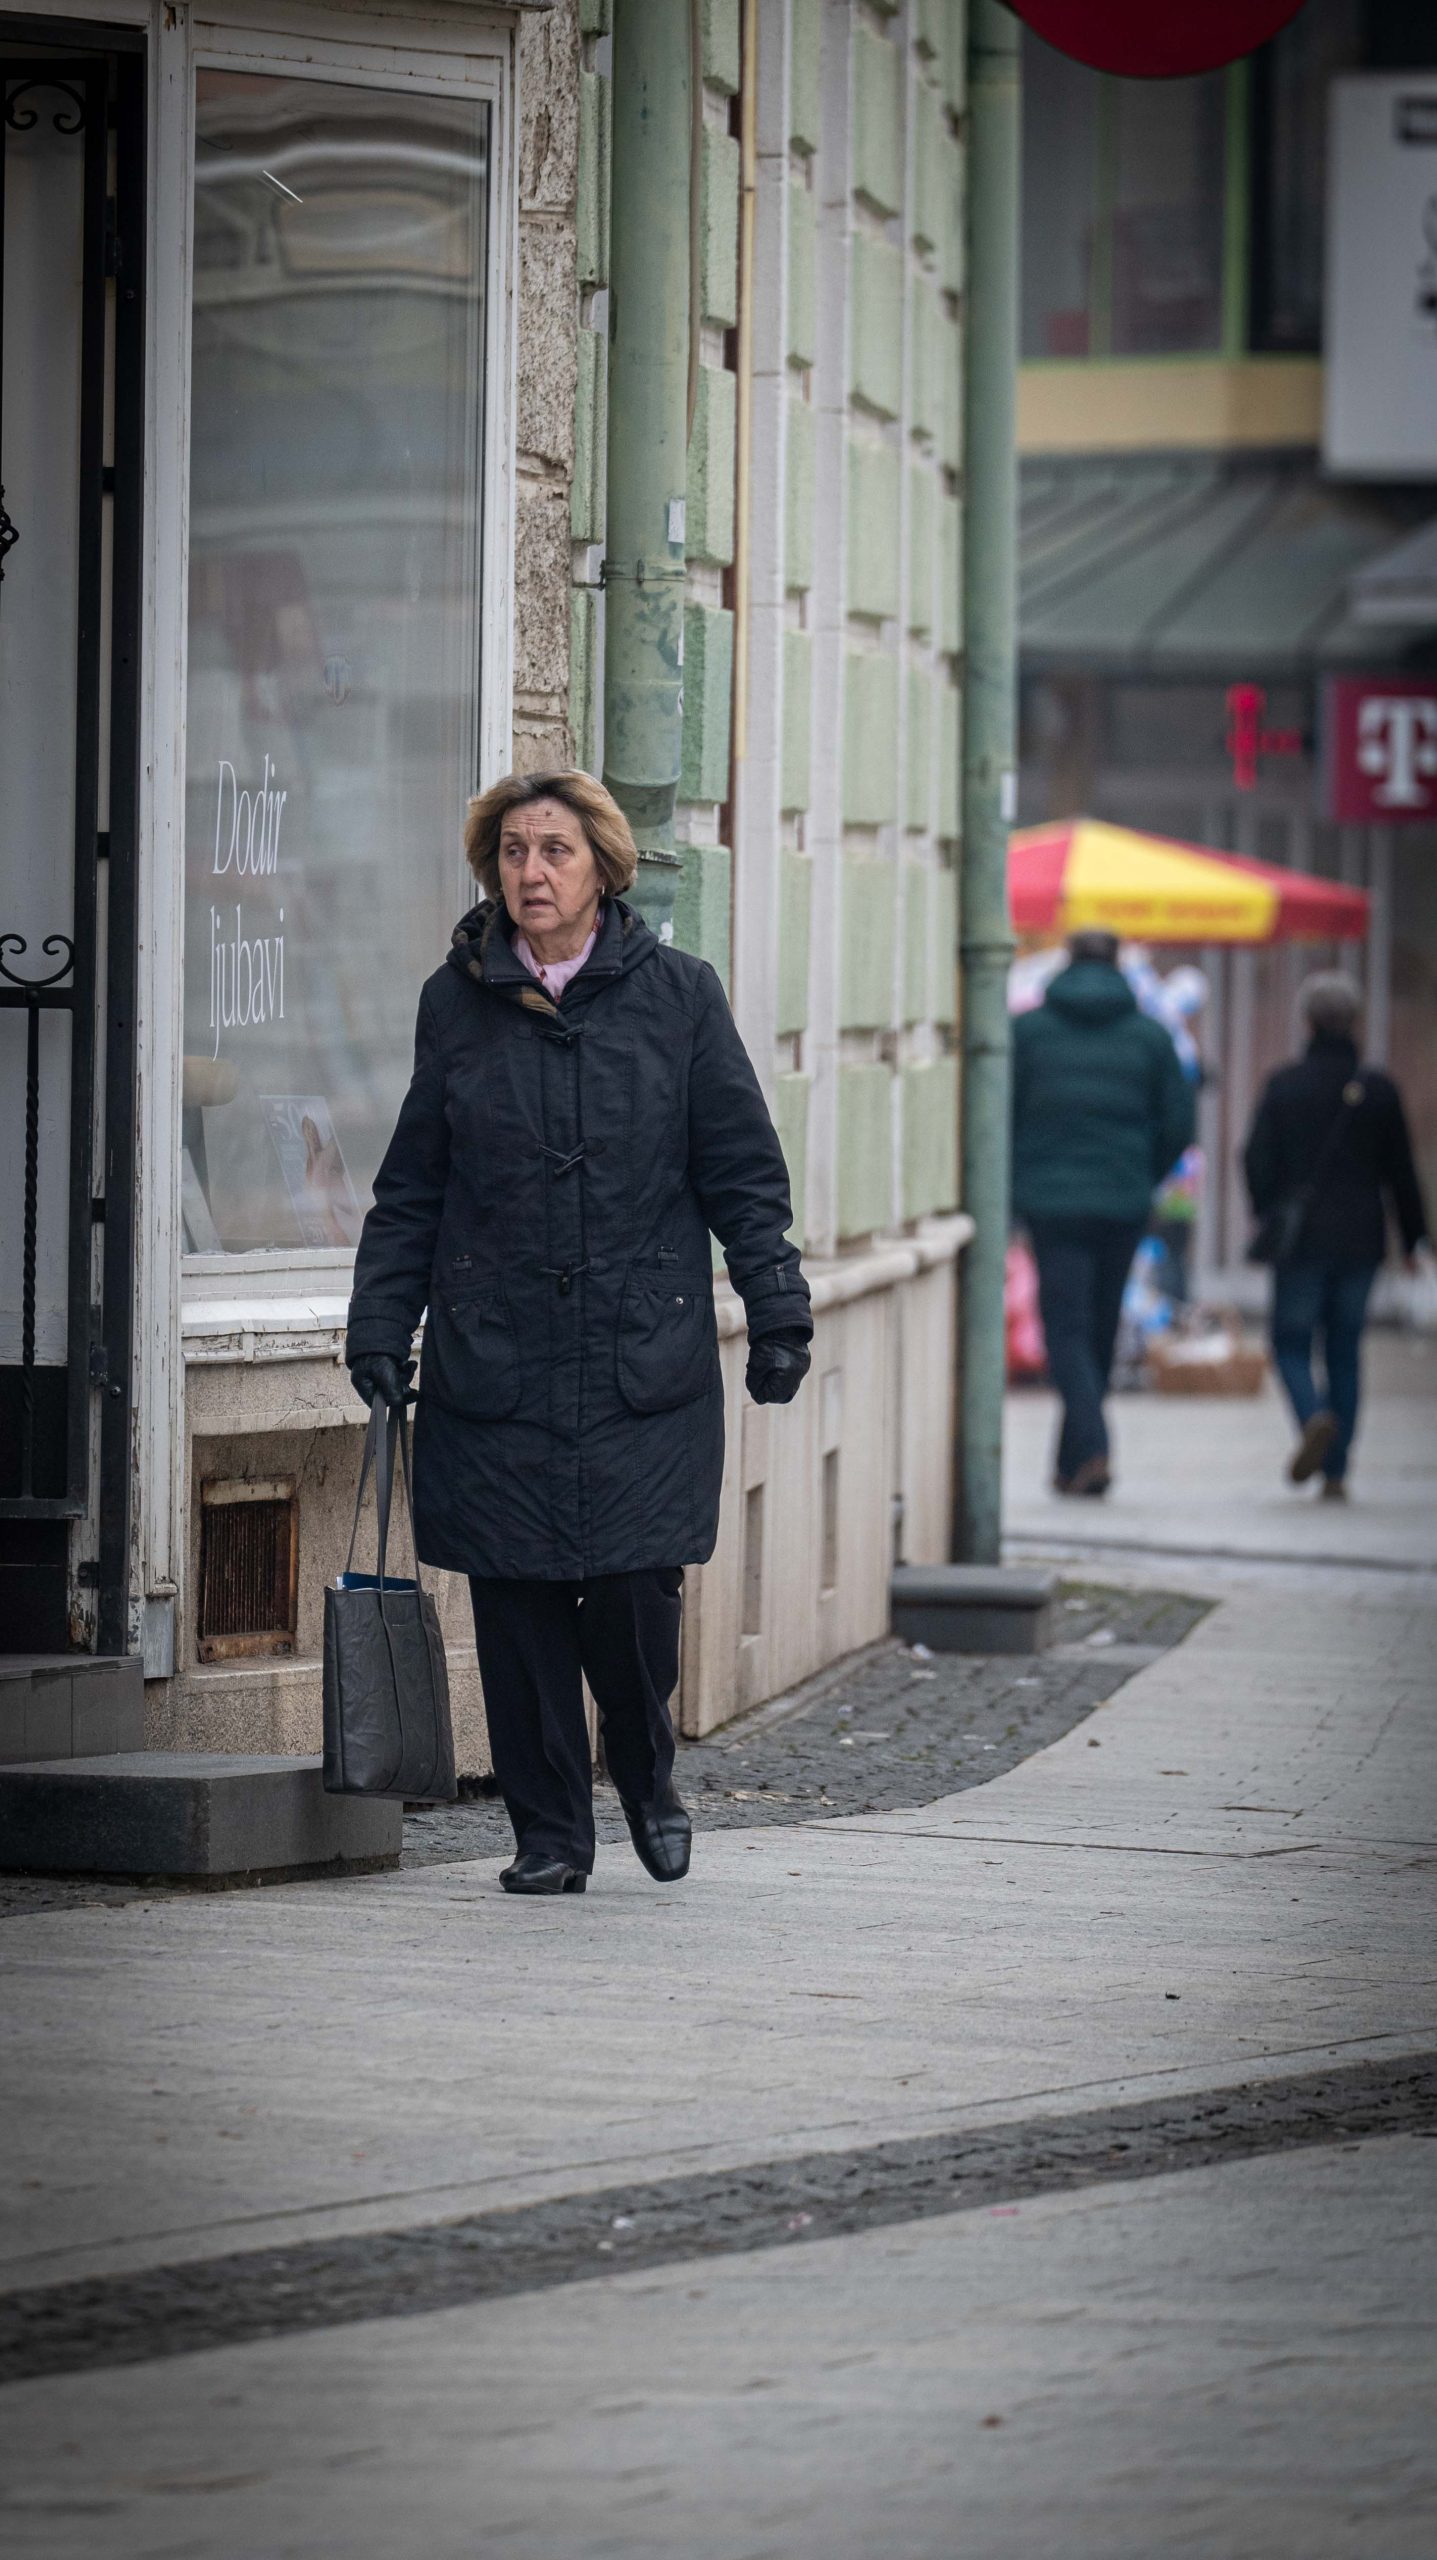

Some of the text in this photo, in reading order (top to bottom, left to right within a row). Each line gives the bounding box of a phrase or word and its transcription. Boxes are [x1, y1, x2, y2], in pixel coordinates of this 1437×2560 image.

[1358, 696, 1437, 808] T
[212, 753, 287, 876] Dodir
[209, 904, 285, 1062] ljubavi
